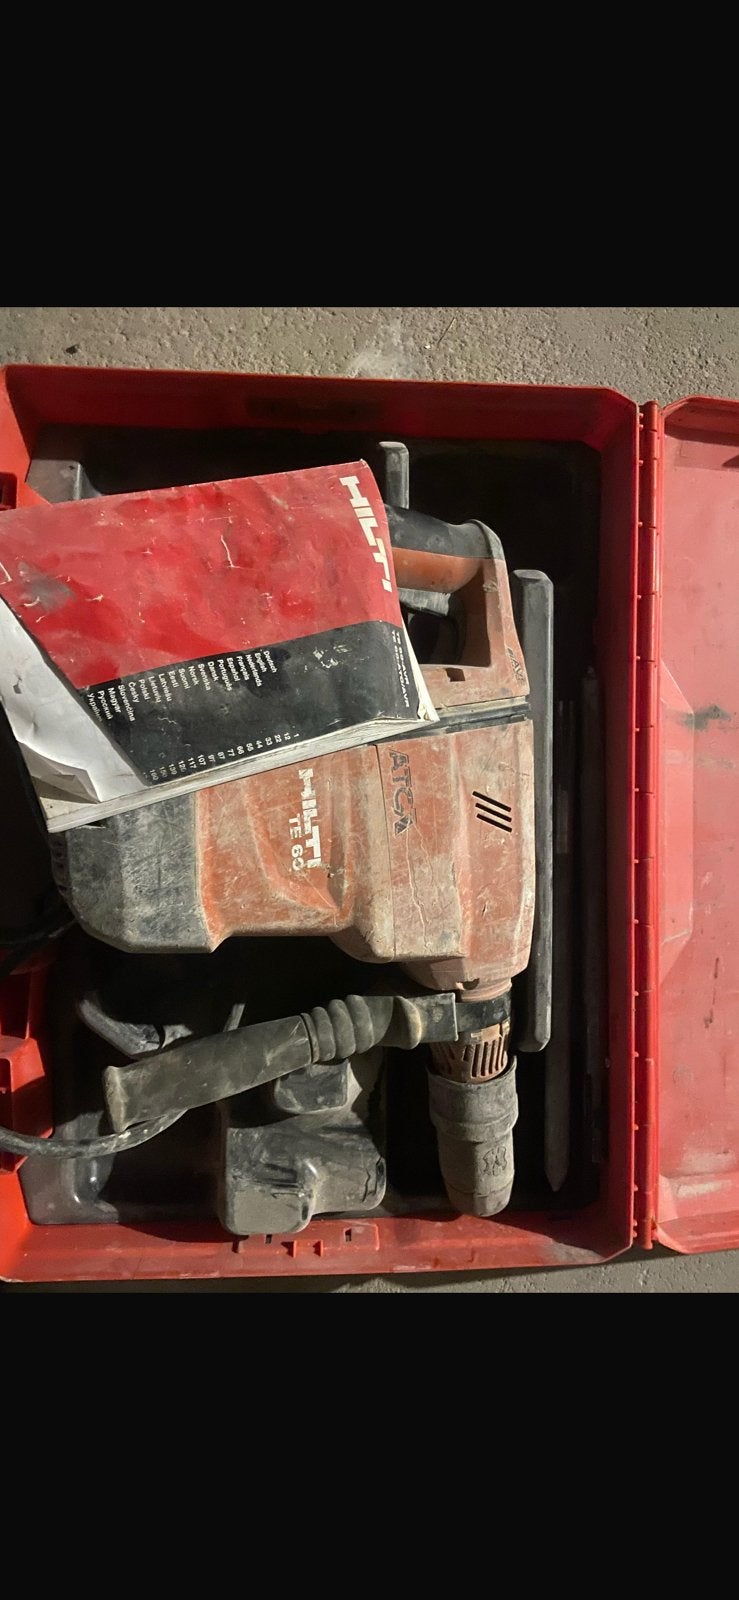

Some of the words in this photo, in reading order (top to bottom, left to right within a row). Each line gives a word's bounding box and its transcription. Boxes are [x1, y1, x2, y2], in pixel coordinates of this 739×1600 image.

[339, 475, 392, 592] HILTI
[128, 681, 140, 703] Česky
[139, 679, 151, 700] Polski
[178, 668, 191, 690] Suomi
[188, 665, 200, 686] Norsk
[207, 661, 219, 682] Dansk
[263, 650, 277, 673] Deutsch
[97, 690, 114, 720] Русский
[107, 687, 121, 713] Magyar
[117, 684, 136, 722] Slovenčina
[158, 673, 172, 702] Latviešu
[187, 757, 197, 769] 117
[168, 670, 180, 688] Eesti
[197, 754, 206, 766] 107
[197, 663, 211, 691] Svenska
[227, 748, 235, 757] 77
[217, 659, 232, 691] Português
[246, 742, 254, 752] 55
[226, 657, 240, 682] Español
[256, 740, 263, 749] 44
[236, 655, 250, 681] Français
[265, 737, 273, 746] 33
[246, 654, 262, 687] Nederlands
[274, 734, 282, 743] 22
[254, 652, 267, 673] English
[283, 732, 291, 740] 12
[289, 813, 302, 839] TE
[298, 768, 321, 868] HILTI
